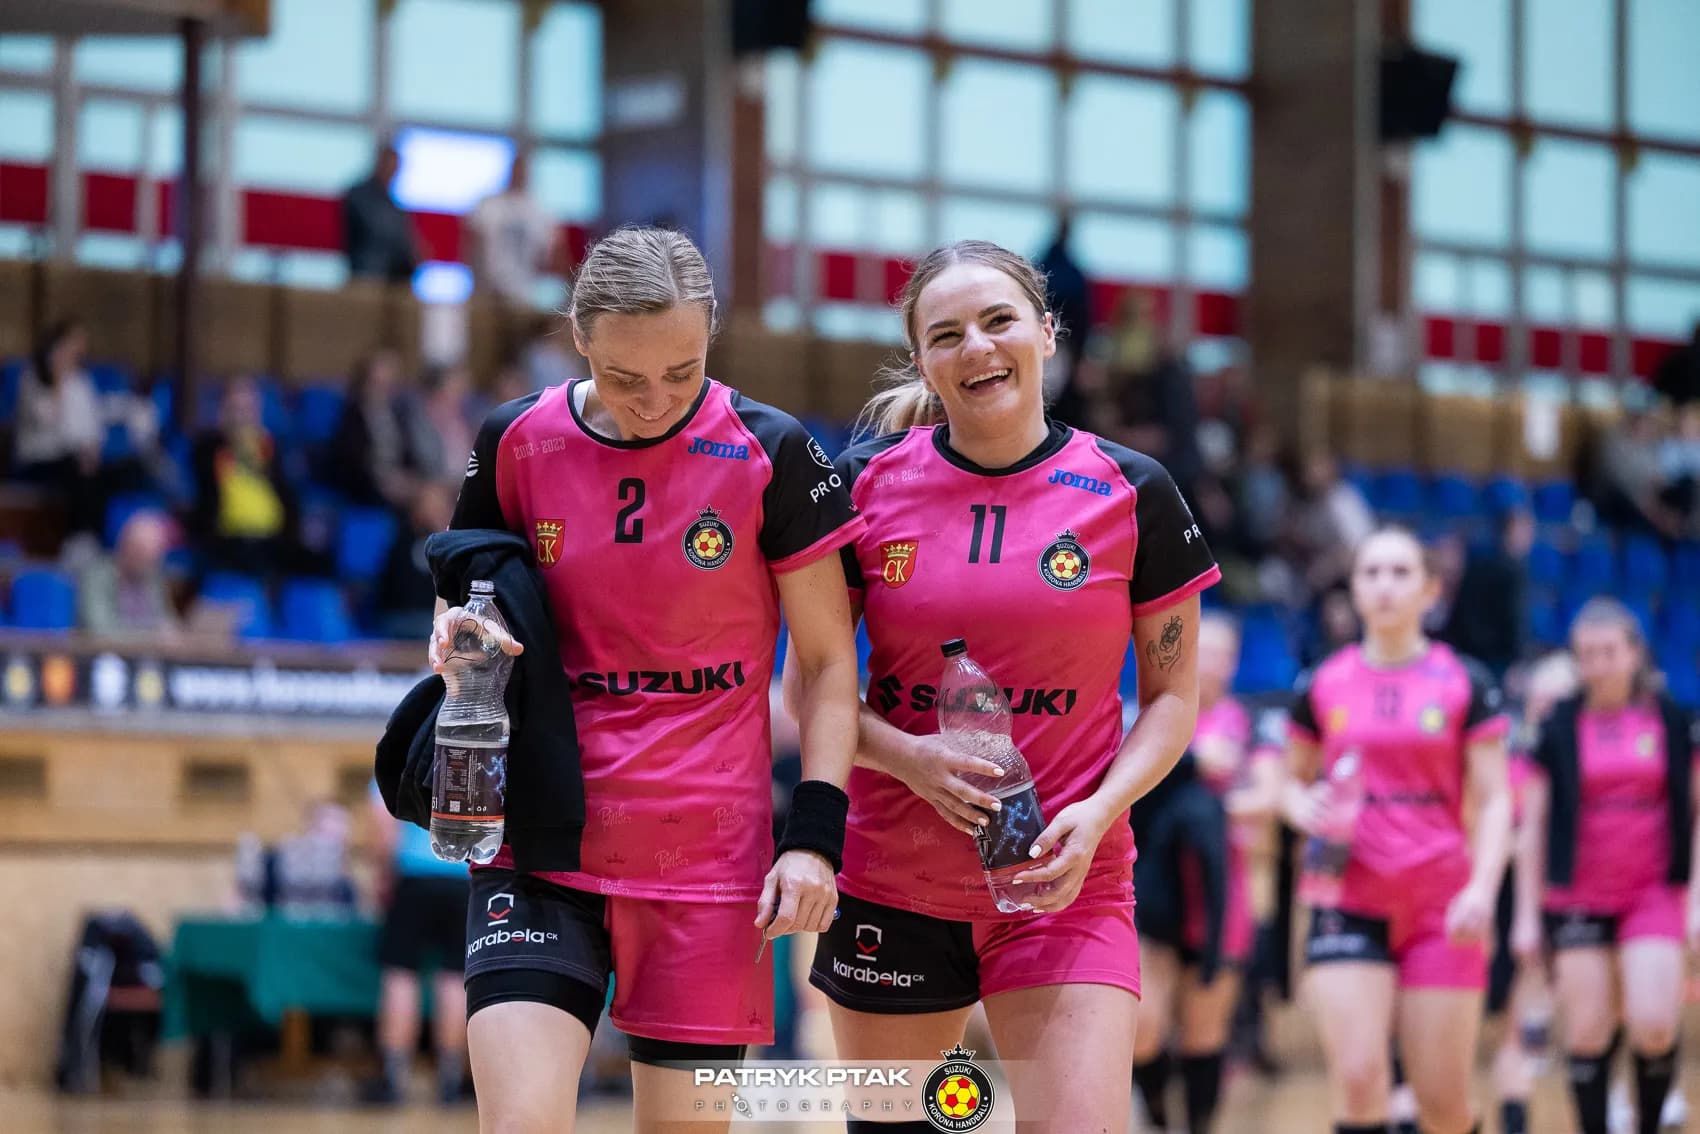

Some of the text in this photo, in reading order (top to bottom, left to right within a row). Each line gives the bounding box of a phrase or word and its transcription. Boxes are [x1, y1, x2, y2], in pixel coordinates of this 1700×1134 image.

[514, 442, 534, 460] 2013
[541, 437, 566, 454] 2023
[810, 473, 841, 504] PRO
[615, 477, 646, 543] 2
[968, 504, 1007, 564] 11
[1184, 523, 1202, 544] PR
[537, 538, 557, 563] CK
[883, 559, 908, 583] CK
[577, 661, 745, 696] SUZUKI
[467, 928, 545, 959] karabela
[833, 956, 925, 987] karabela CK
